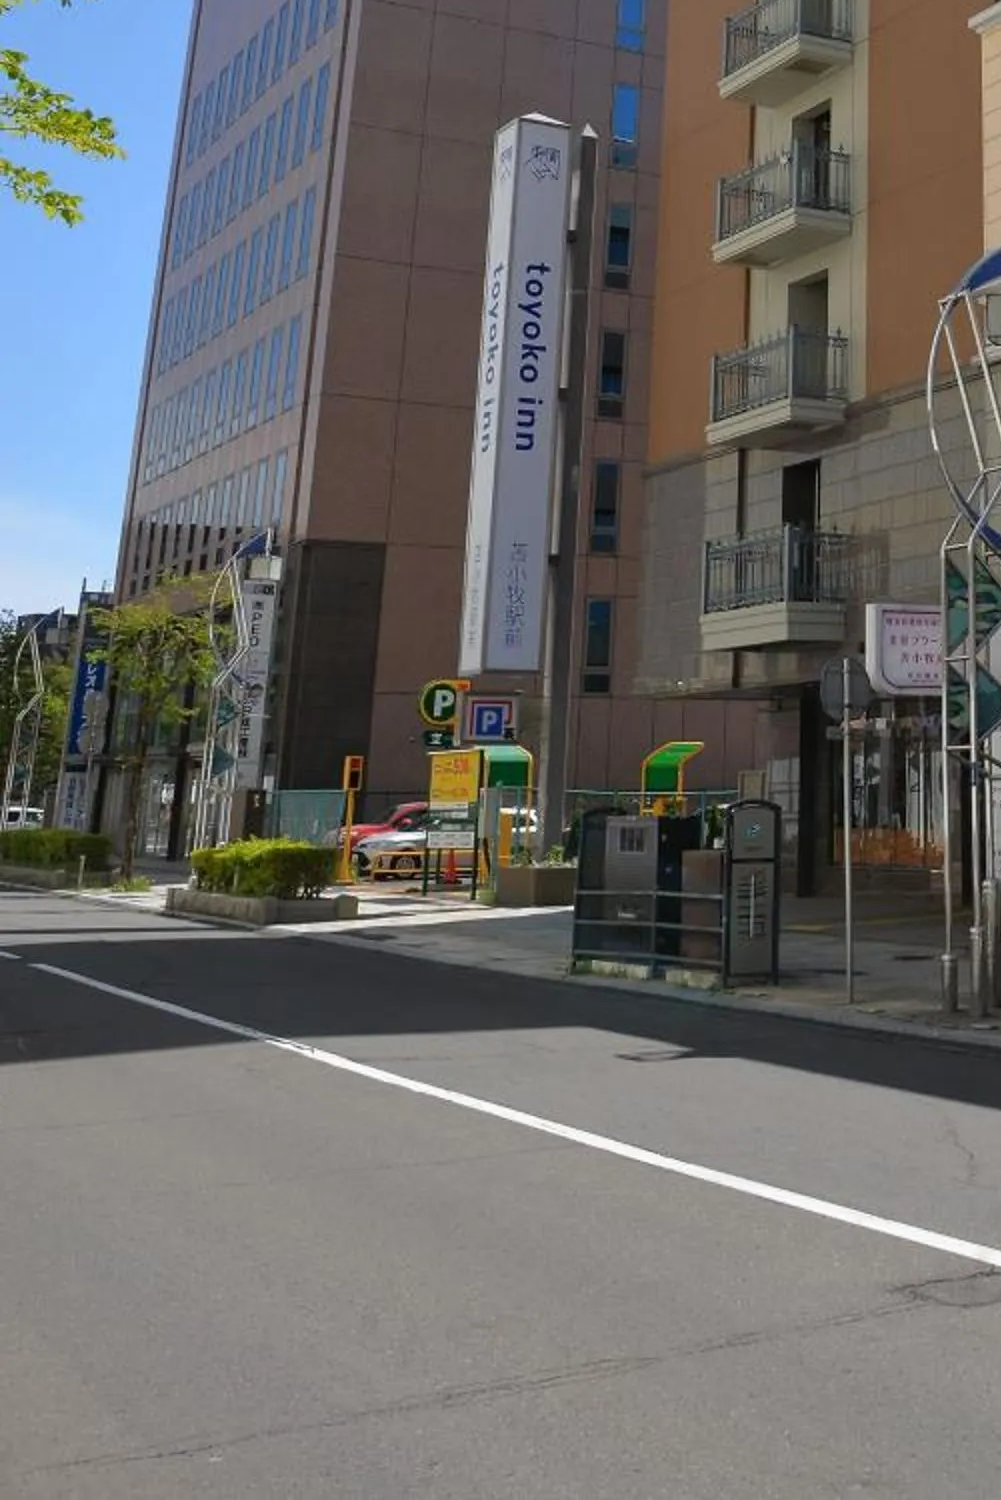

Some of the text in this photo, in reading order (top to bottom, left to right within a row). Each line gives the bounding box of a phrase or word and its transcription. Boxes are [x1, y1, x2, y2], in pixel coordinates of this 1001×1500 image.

[481, 261, 505, 454] toyoko inn
[515, 262, 550, 452] toyoko inn
[433, 688, 455, 718] P
[481, 709, 497, 733] P
